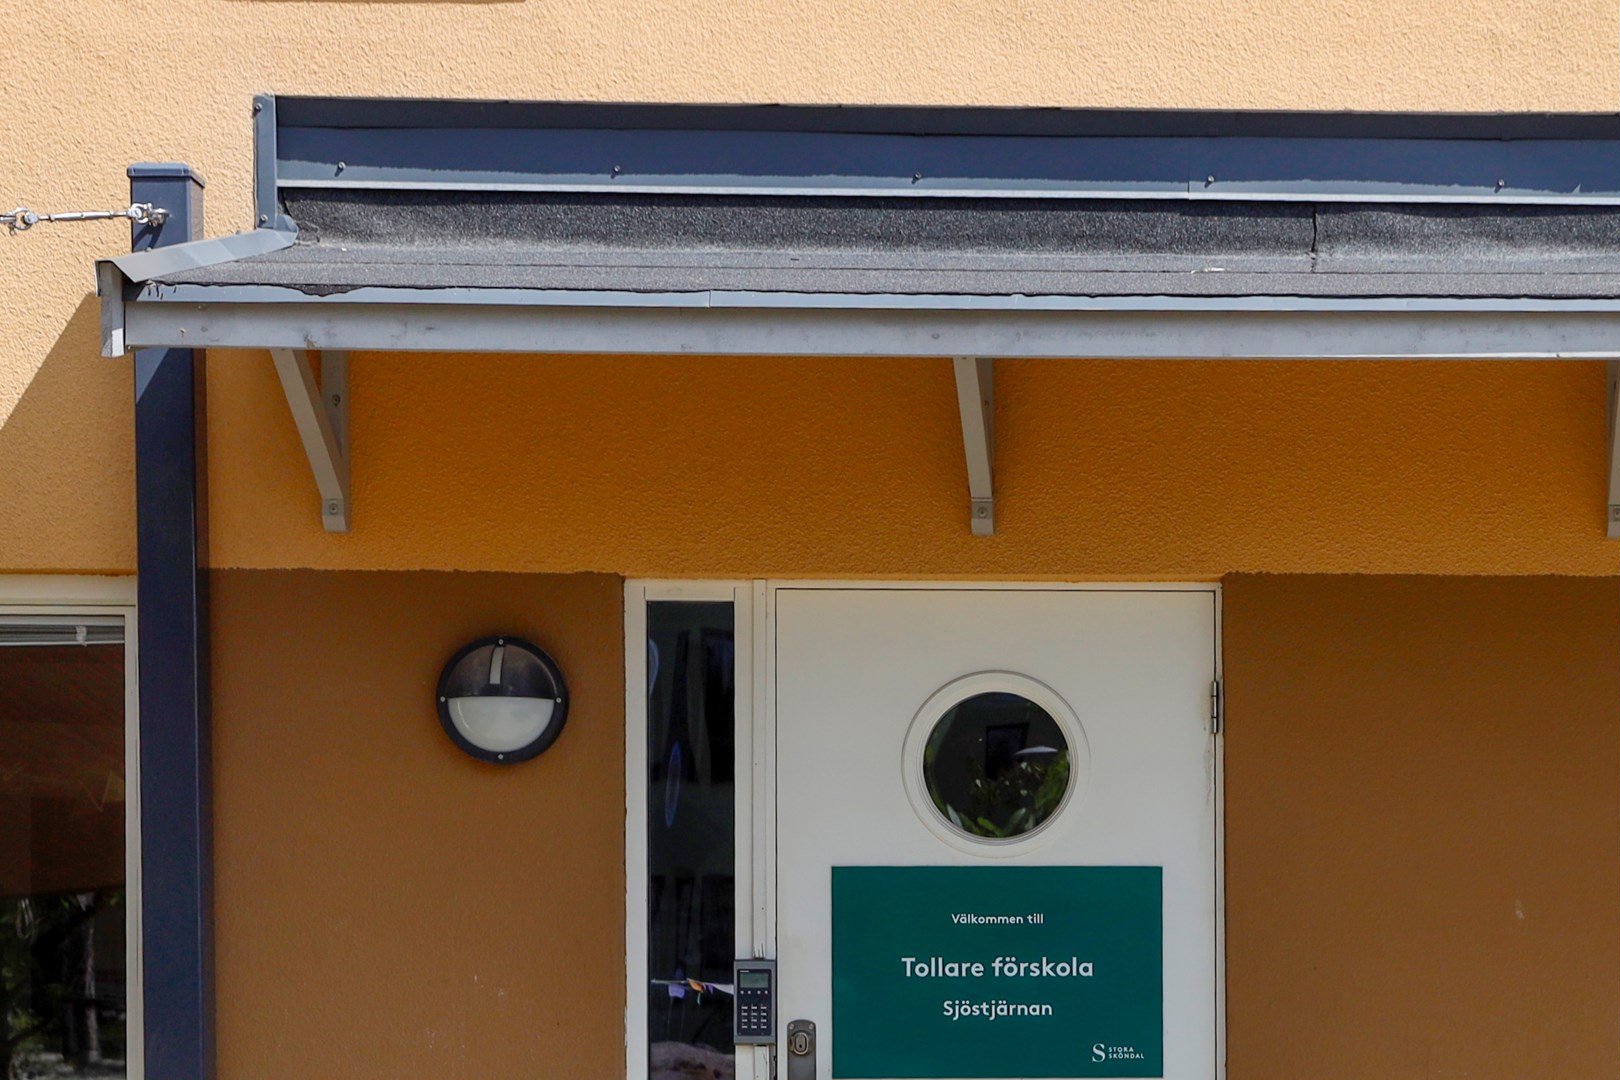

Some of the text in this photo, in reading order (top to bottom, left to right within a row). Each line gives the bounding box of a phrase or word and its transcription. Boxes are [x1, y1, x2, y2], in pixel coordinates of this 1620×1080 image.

[951, 913, 1044, 925] Välkommen till
[901, 956, 1094, 978] Tollare förskola
[942, 1000, 1053, 1021] Sjöstjärnan
